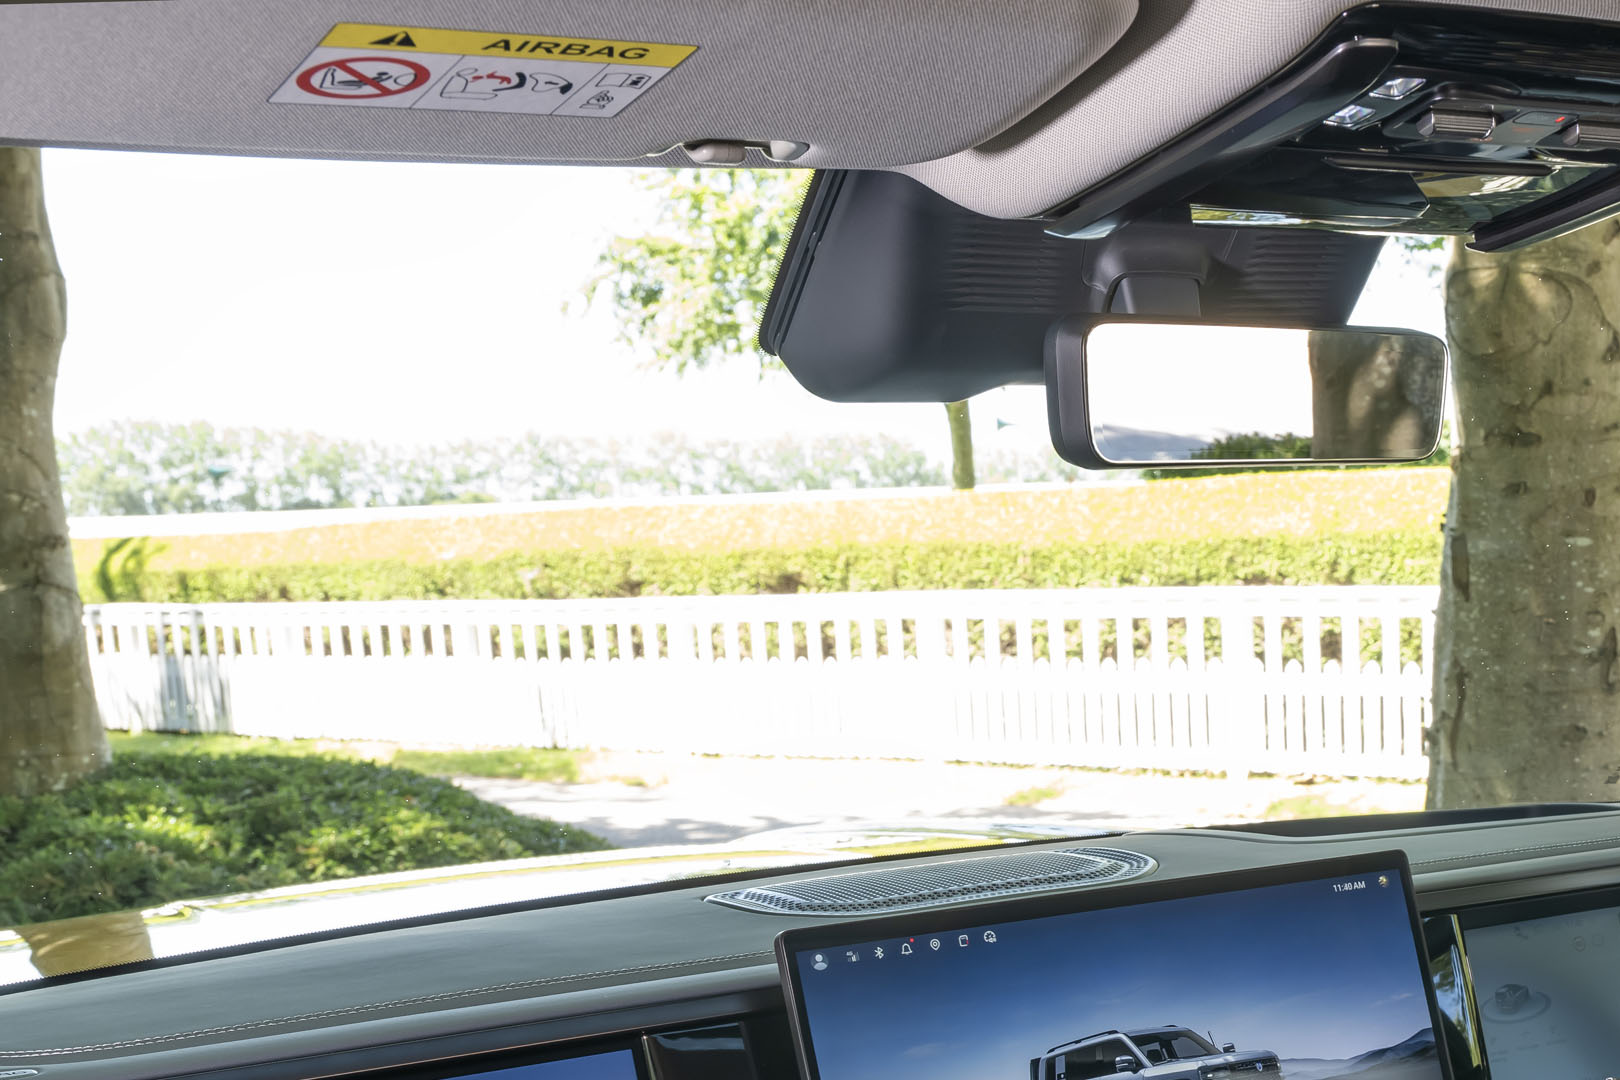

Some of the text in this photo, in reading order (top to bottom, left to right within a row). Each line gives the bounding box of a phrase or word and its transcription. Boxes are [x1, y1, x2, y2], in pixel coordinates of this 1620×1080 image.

[483, 39, 650, 59] AIRBAG
[1332, 880, 1366, 892] 11:40 AM
